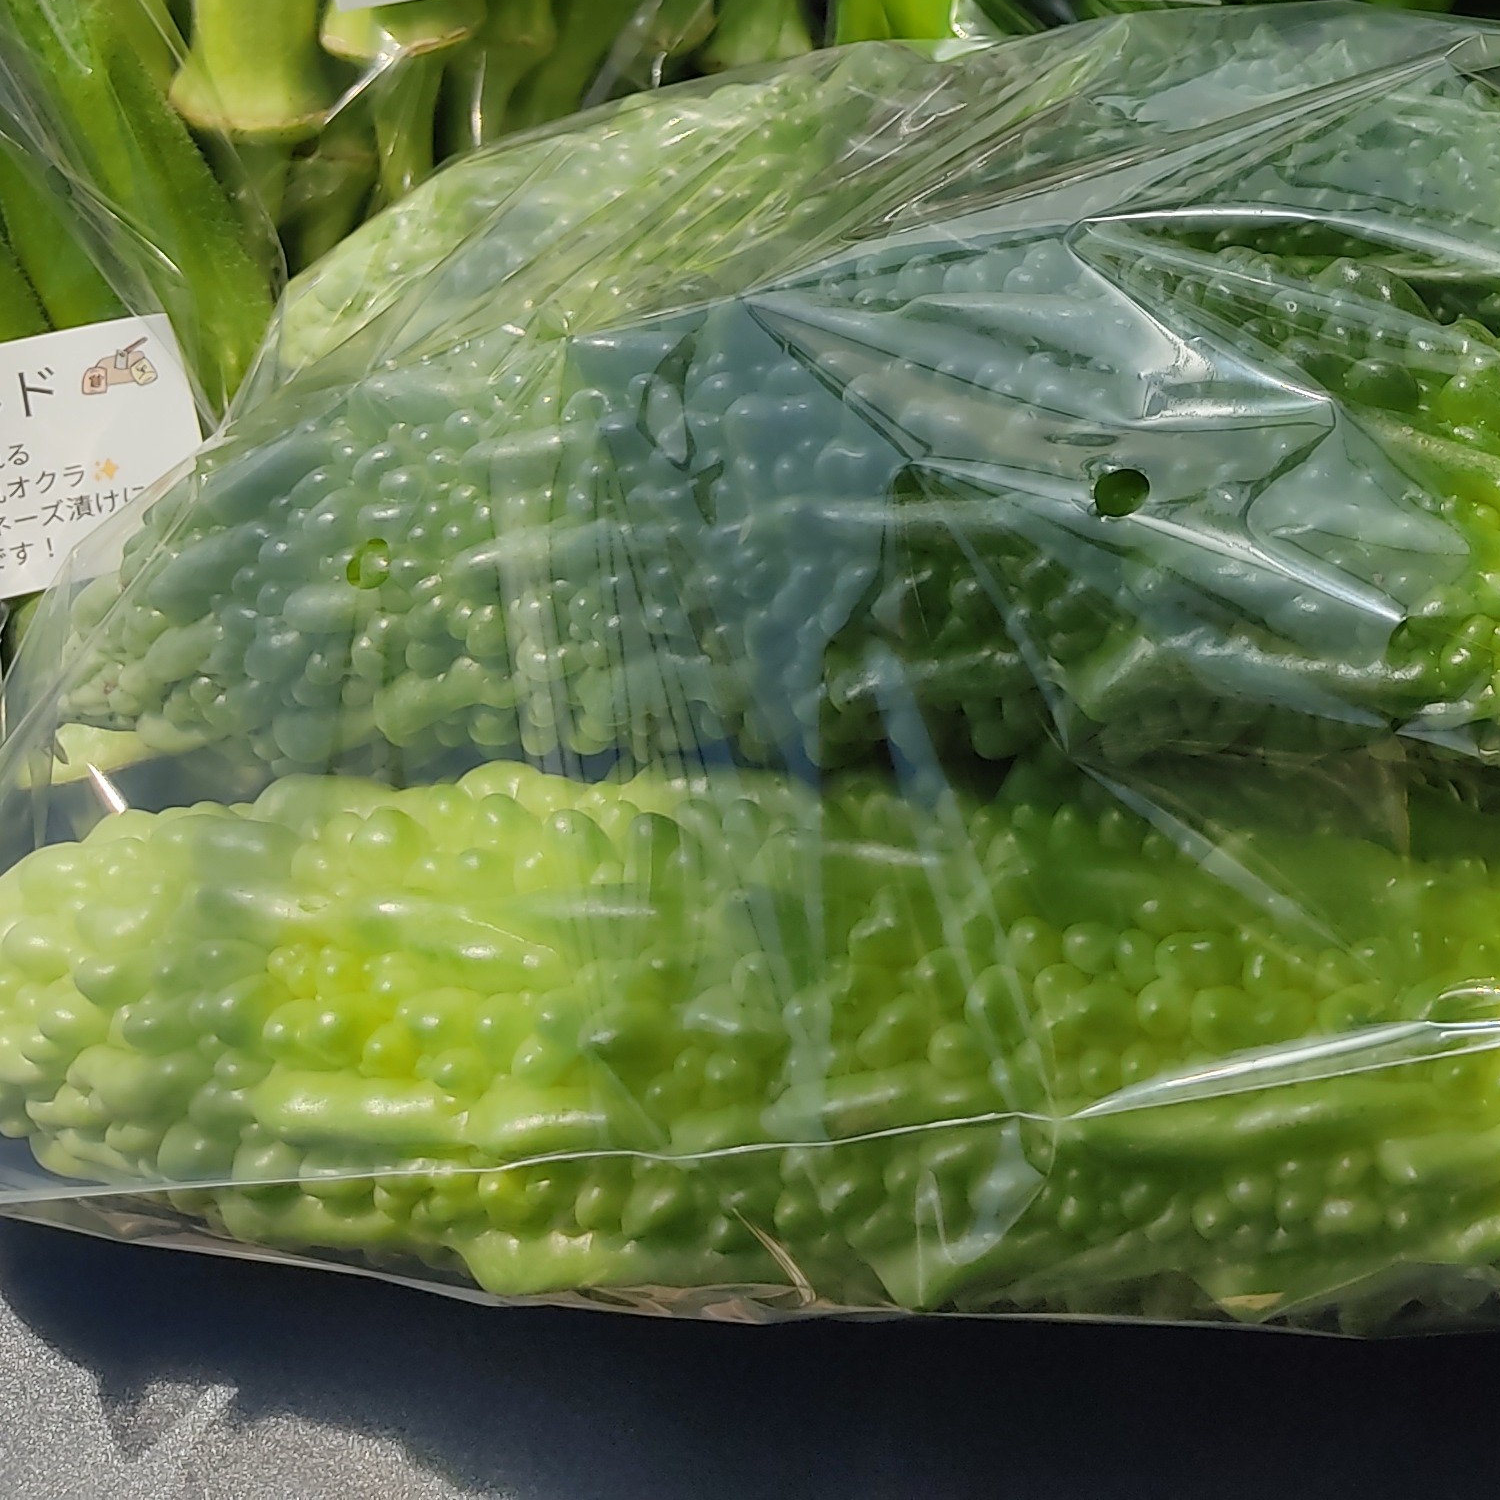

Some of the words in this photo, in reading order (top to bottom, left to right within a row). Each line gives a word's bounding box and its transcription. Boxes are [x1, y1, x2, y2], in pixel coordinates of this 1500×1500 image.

[0, 367, 54, 417] ド
[0, 443, 30, 469] る
[0, 465, 85, 504] オクラ
